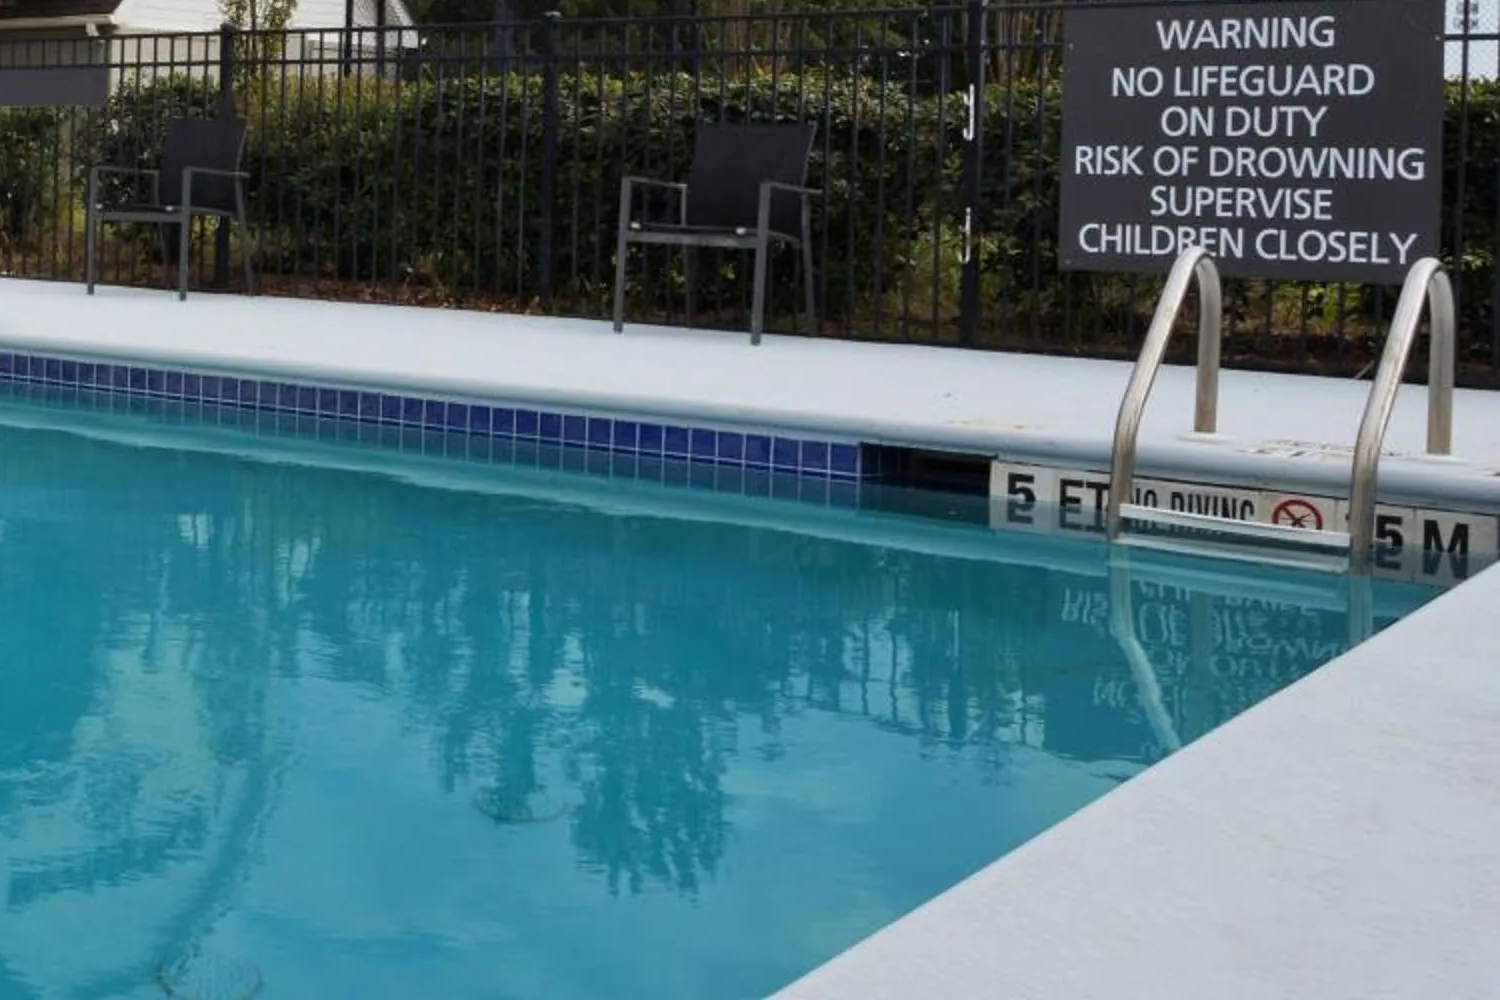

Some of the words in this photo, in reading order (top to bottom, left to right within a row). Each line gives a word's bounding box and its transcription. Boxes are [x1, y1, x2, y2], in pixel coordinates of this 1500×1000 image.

[1156, 16, 1335, 50] WARNING
[1112, 67, 1163, 97] NO
[1175, 64, 1375, 97] LIFEGUARD
[1161, 106, 1214, 137] ON
[1226, 106, 1328, 137] DUTY
[1075, 145, 1143, 176] RISK
[1153, 145, 1199, 177] OF
[1209, 147, 1425, 180] DROWNING
[1150, 186, 1333, 220] SUPERVISE
[1078, 223, 1244, 259] CHILDREN
[1255, 228, 1418, 264] CLOSELY
[1007, 472, 1036, 504] 5
